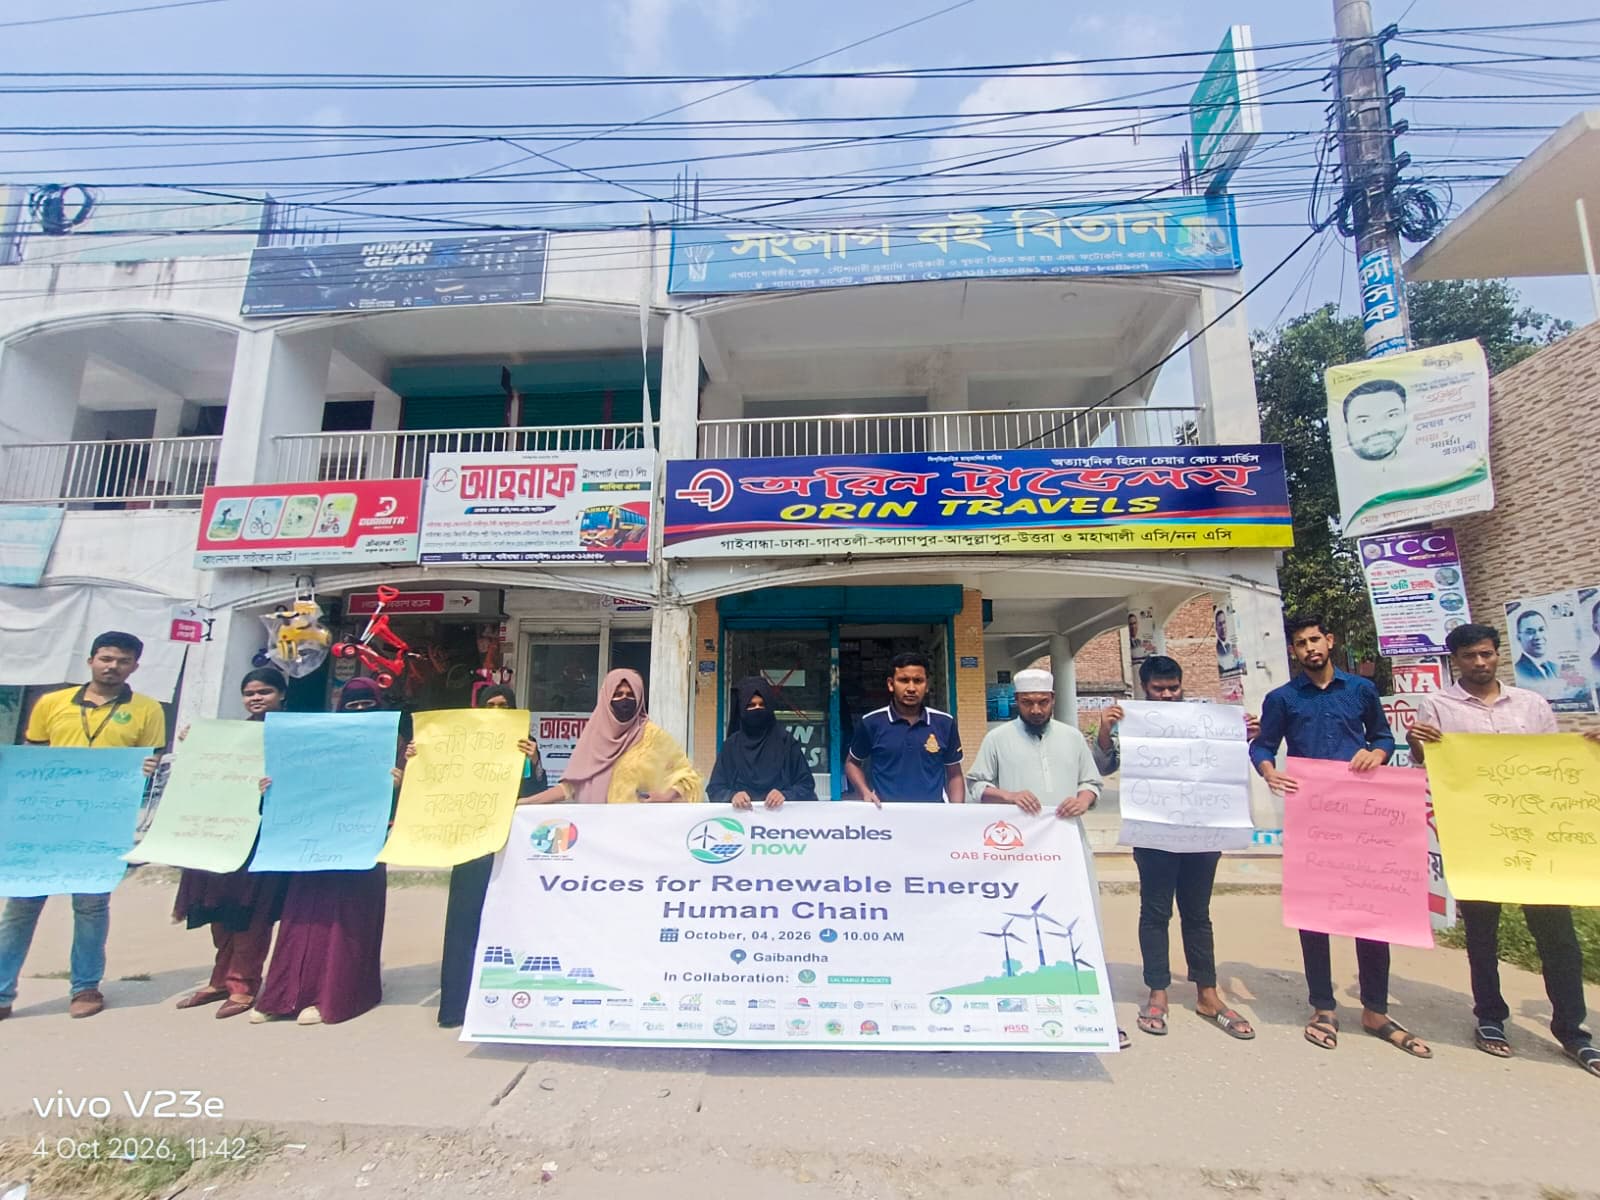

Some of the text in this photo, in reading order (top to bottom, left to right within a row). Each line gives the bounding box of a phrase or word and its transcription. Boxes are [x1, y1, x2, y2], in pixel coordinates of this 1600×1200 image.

[725, 208, 1175, 265] সংলাপ বই বিতান
[360, 241, 433, 256] HUMAN
[1051, 452, 1259, 467] অত্যাধুনিক হিনো চেয়ার কোচ সার্ভিস
[460, 463, 579, 501] আহনাফ
[738, 467, 939, 499] অরিন
[780, 496, 1161, 520] ORIN TRAVELS
[1062, 533, 1072, 543] ও
[1078, 528, 1134, 543] মহাখালী
[1141, 530, 1196, 543] এসি/নন
[1203, 529, 1232, 541] এসি
[1381, 535, 1448, 558] ICC
[1136, 744, 1180, 768] Save
[750, 824, 892, 841] Renewables
[751, 843, 807, 856] now
[950, 851, 1062, 862] OAB Foundation
[539, 875, 1020, 899] Voices for Renewable Energy
[663, 900, 889, 921] Human Chain
[684, 930, 747, 943] October,
[842, 931, 879, 943] 10.00
[883, 931, 905, 943] AM
[752, 951, 829, 963] Gaibandha
[663, 971, 790, 984] In Collaboration:
